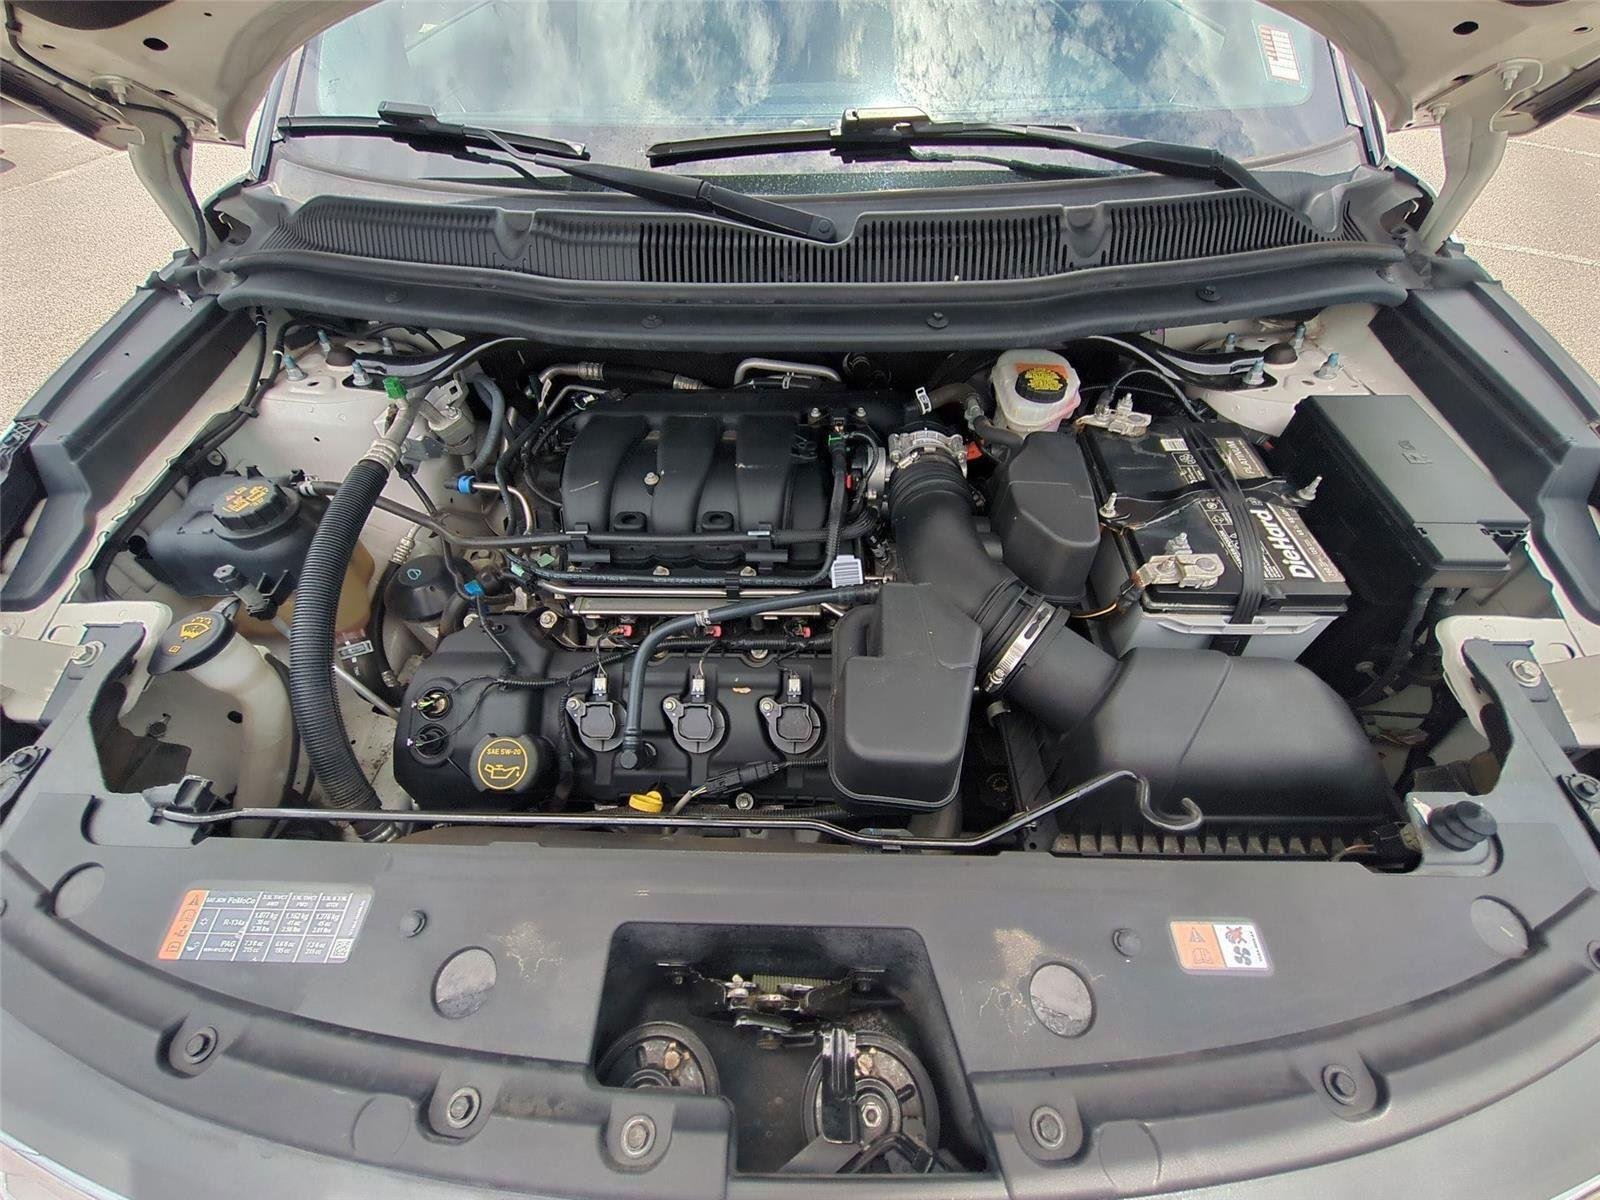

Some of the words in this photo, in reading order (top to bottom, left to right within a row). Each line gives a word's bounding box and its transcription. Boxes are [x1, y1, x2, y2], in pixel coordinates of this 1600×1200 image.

[1225, 440, 1256, 475] PLATINUM
[1250, 509, 1315, 579] DieHard
[226, 896, 256, 905] FoMoCo
[300, 912, 310, 921] kg
[330, 913, 340, 922] kg
